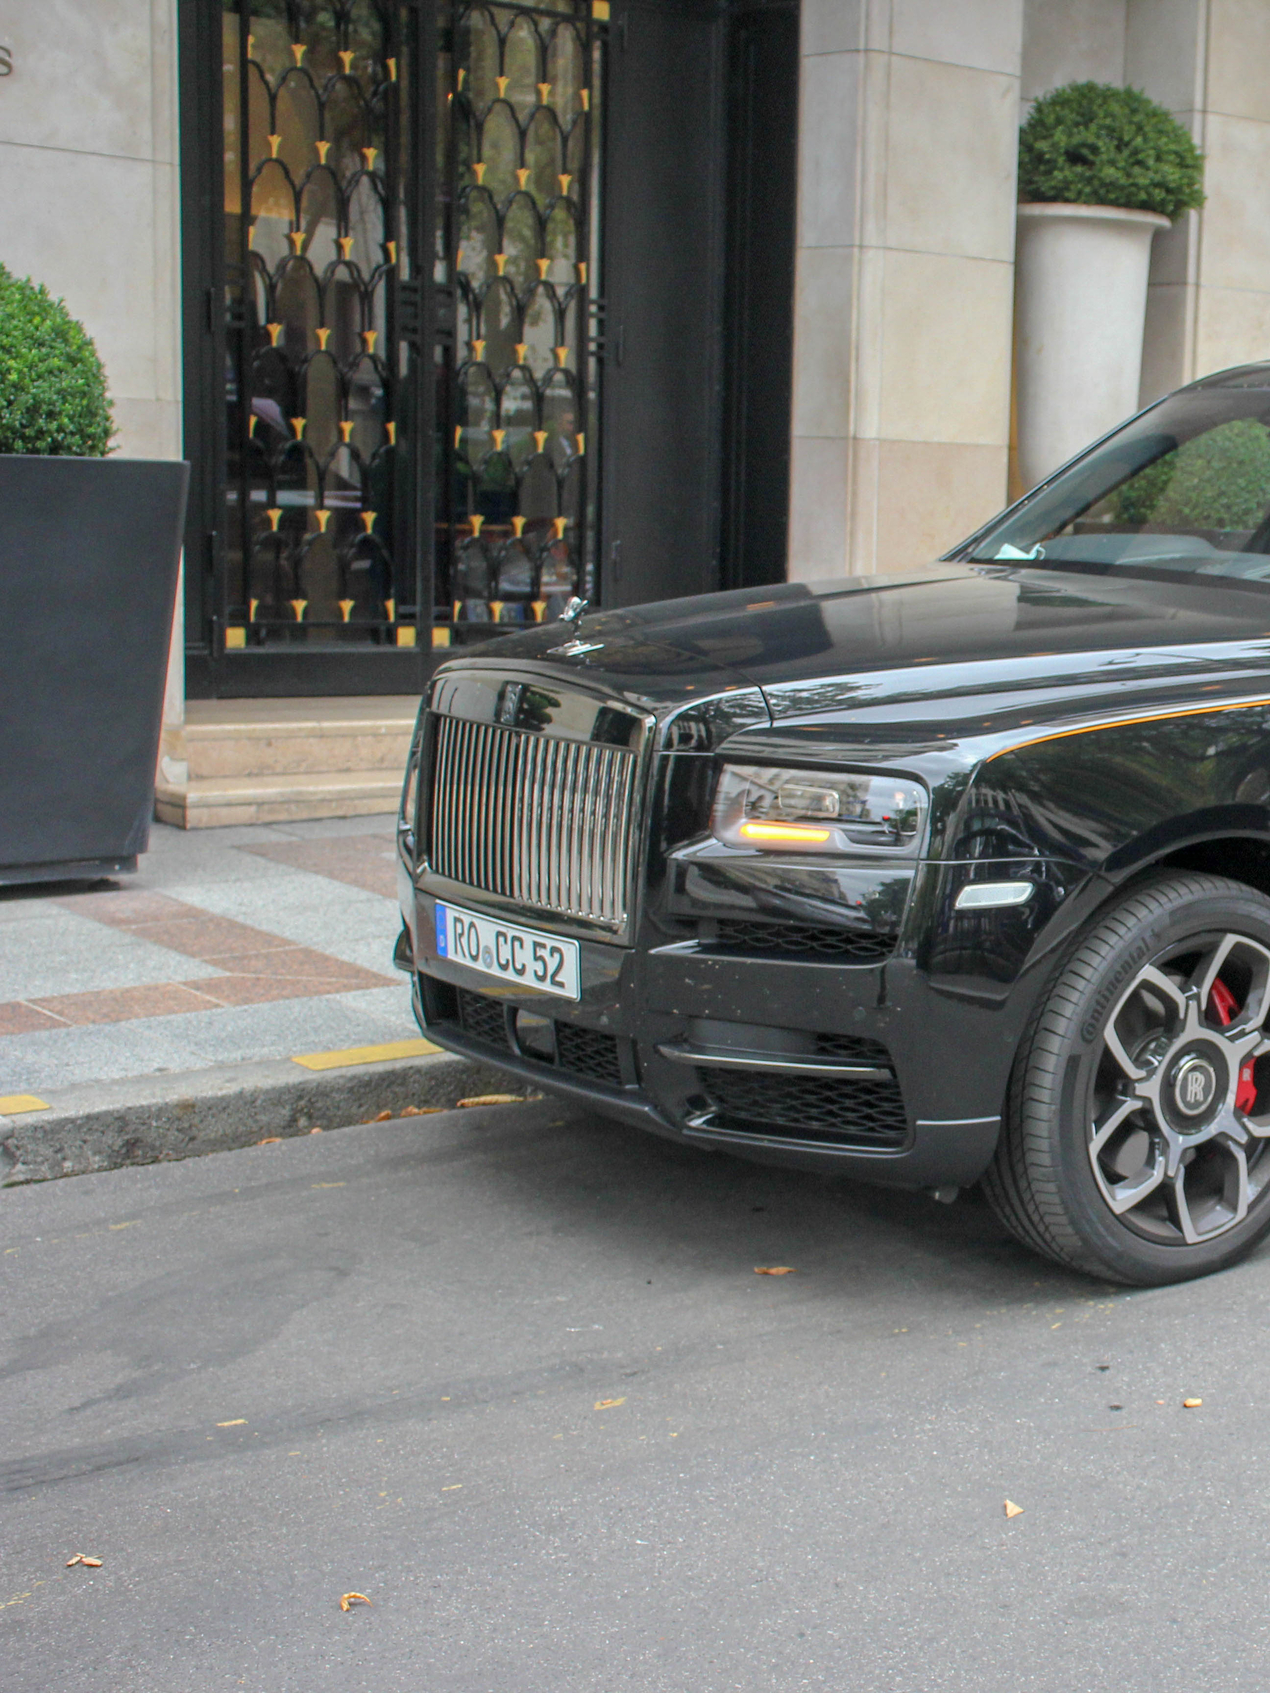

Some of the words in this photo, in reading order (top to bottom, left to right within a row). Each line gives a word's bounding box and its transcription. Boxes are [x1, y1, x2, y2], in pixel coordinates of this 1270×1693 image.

[453, 915, 481, 963] RO
[496, 929, 527, 977] CC
[532, 939, 566, 990] 52
[1081, 936, 1152, 1044] Continental
